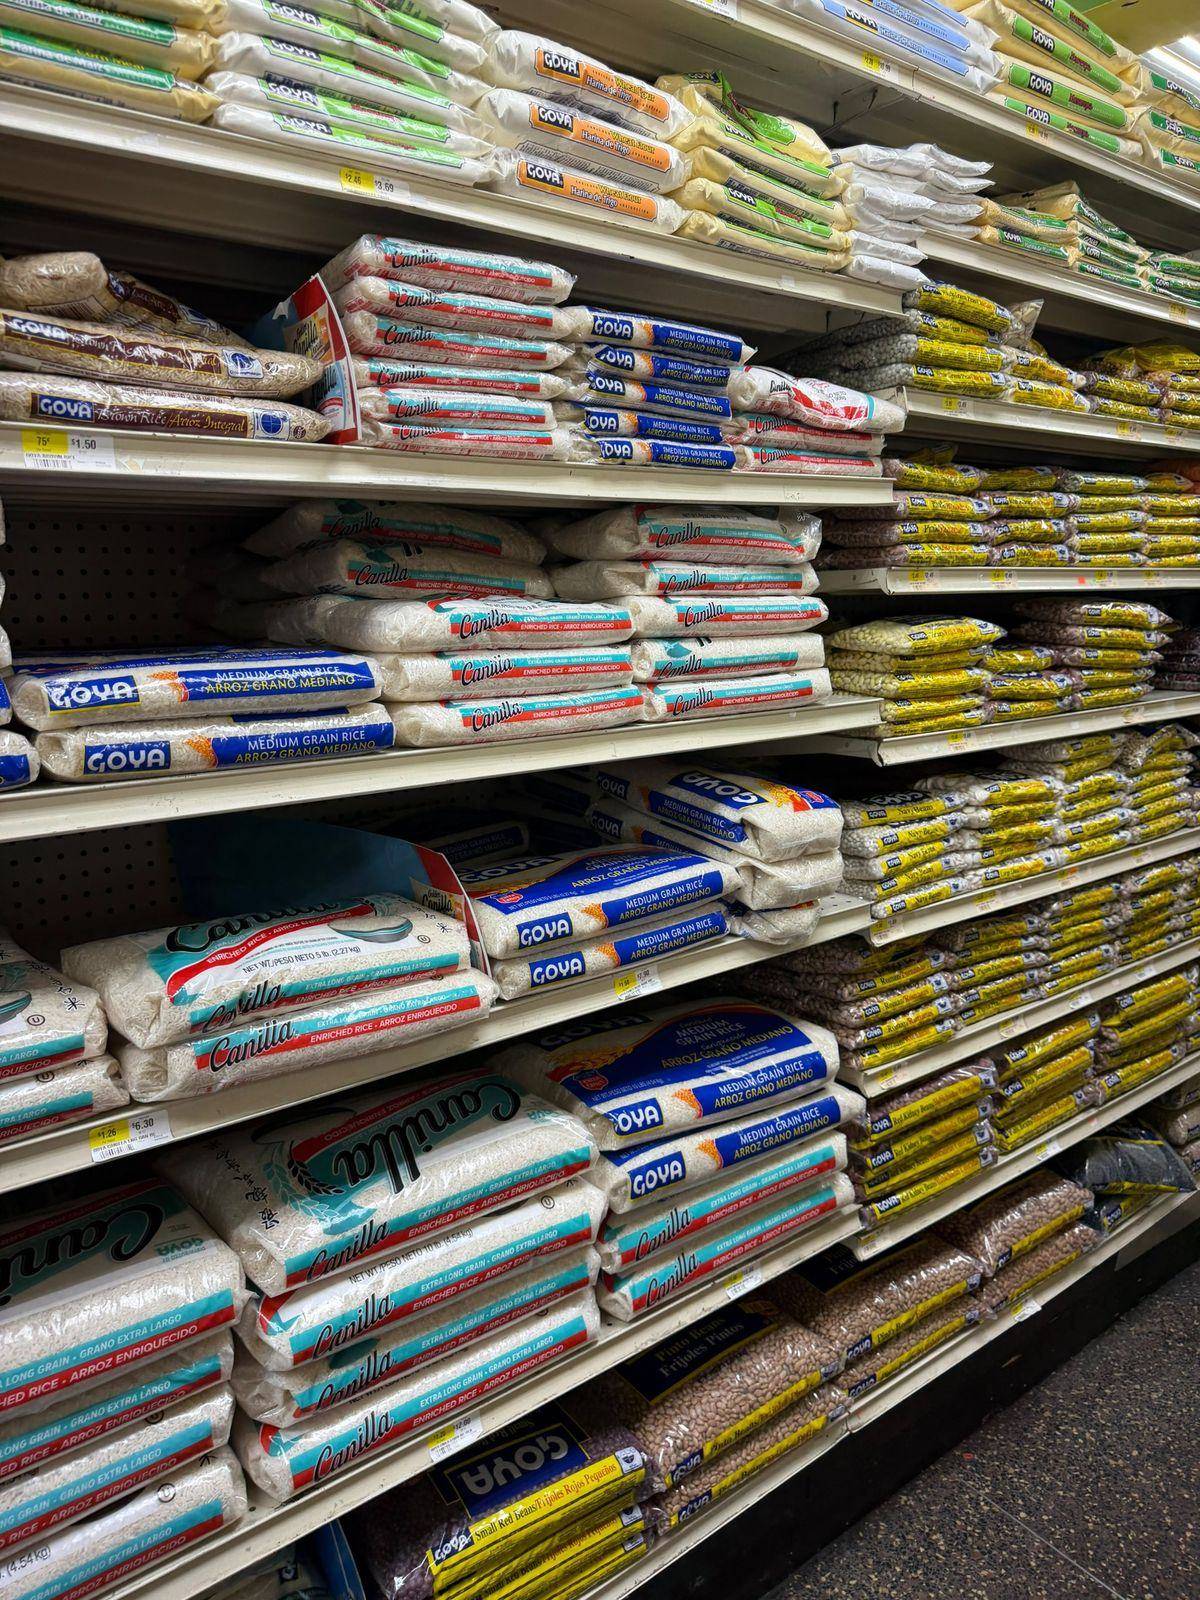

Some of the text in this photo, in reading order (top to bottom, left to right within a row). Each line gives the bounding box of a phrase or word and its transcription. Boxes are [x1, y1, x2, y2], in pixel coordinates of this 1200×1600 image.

[1033, 28, 1055, 50] GOYA
[544, 51, 577, 75] GOYA
[1031, 74, 1053, 96] GOYA
[539, 105, 573, 132] GOYA
[1026, 106, 1050, 124] GOYA
[581, 130, 604, 147] Harina
[528, 164, 562, 186] GOYA
[571, 186, 593, 201] Harina
[602, 194, 618, 208] Trigo
[594, 317, 633, 340] GOYA
[669, 330, 730, 349] MEDIUM GRAIN RICE
[39, 400, 92, 421] GOYA
[395, 397, 440, 419] Canilla
[654, 393, 723, 413] ARROZ GRANO MEDIANO
[204, 415, 246, 435] Integral
[71, 438, 97, 450] $1.50
[328, 510, 385, 538] Canilla
[656, 521, 703, 549] Canilla
[355, 562, 409, 586] Canilla
[663, 570, 709, 594] Canilla
[459, 608, 511, 640] Canilla
[684, 601, 725, 628] Canilla
[205, 681, 250, 695] ARROZ
[300, 674, 356, 689] MEDIANO
[461, 656, 514, 687] Canilla
[472, 700, 524, 732] Canilla
[673, 688, 714, 716] Canilla
[235, 740, 376, 764] ARROZ GRANO MEDIANO
[247, 730, 366, 751] MEDIUM GRAIN RICE
[86, 749, 168, 773] GOYA
[682, 772, 759, 804] GOYA
[663, 799, 711, 824] MEDIUM GRAIN
[619, 886, 711, 921] ARROZ GRANO MEDIANO
[625, 879, 704, 910] MEDIUM GRAIN RICE
[519, 920, 571, 948] GOYA
[630, 925, 720, 960] ARROZ GRANO MEDIANO
[636, 917, 713, 948] MEDIUM GRAIN RICE
[206, 946, 247, 964] ENRICHED
[248, 932, 267, 948] RICE
[243, 964, 259, 975] NET
[295, 952, 315, 965] NETO
[532, 958, 584, 987] GOYA
[202, 979, 286, 1034] Canilla
[310, 1003, 458, 1043] ENRICHED RICE ARROZ ENRIQUECIDO
[210, 1018, 295, 1072] Canilla
[661, 1053, 702, 1070] ARROZ
[743, 1025, 794, 1048] MEDIANO
[714, 1068, 814, 1109] ARROZ GRANO MEDIANO
[718, 1060, 805, 1096] MEDIUM GRAIN RICE
[98, 1128, 117, 1139] $1.26
[131, 1117, 154, 1131] $6.30
[332, 1082, 522, 1195] Canilla
[733, 1114, 830, 1160] ARROZ GRANO MEDIANO
[740, 1106, 820, 1145] MEDIUM GRAIN RICE
[872, 1150, 893, 1167] GOYA
[632, 1158, 684, 1195] GOYA
[635, 1207, 693, 1263] Canilla
[306, 1219, 391, 1283] Canilla
[349, 1272, 366, 1286] NET
[401, 1249, 423, 1263] NETO
[443, 1233, 462, 1248] (4.54
[462, 1228, 474, 1240] kg)
[645, 1252, 700, 1308] Canilla
[312, 1293, 394, 1361] Canilla
[5, 1313, 182, 1387] LONG GRAIN GRANO EXTRA LARGO
[28, 1324, 198, 1398] RICE ARROZ ENRIQUECIDO
[412, 1344, 564, 1427] ENRICHED RICE ARROZ ENRIQUECIDO
[420, 1336, 554, 1409] EXTRA LONG GRAIN GRANO EXTRA LARGO
[313, 1409, 395, 1482] Canilla
[459, 1435, 569, 1496] GOYA
[474, 1522, 497, 1542] Small
[497, 1512, 514, 1529] Red
[563, 1480, 586, 1498] Rojos
[584, 1463, 617, 1490] Pequeños
[7, 1546, 51, 1574] (4.54 kg)
[105, 1535, 187, 1581] ENRIQUECIDO
